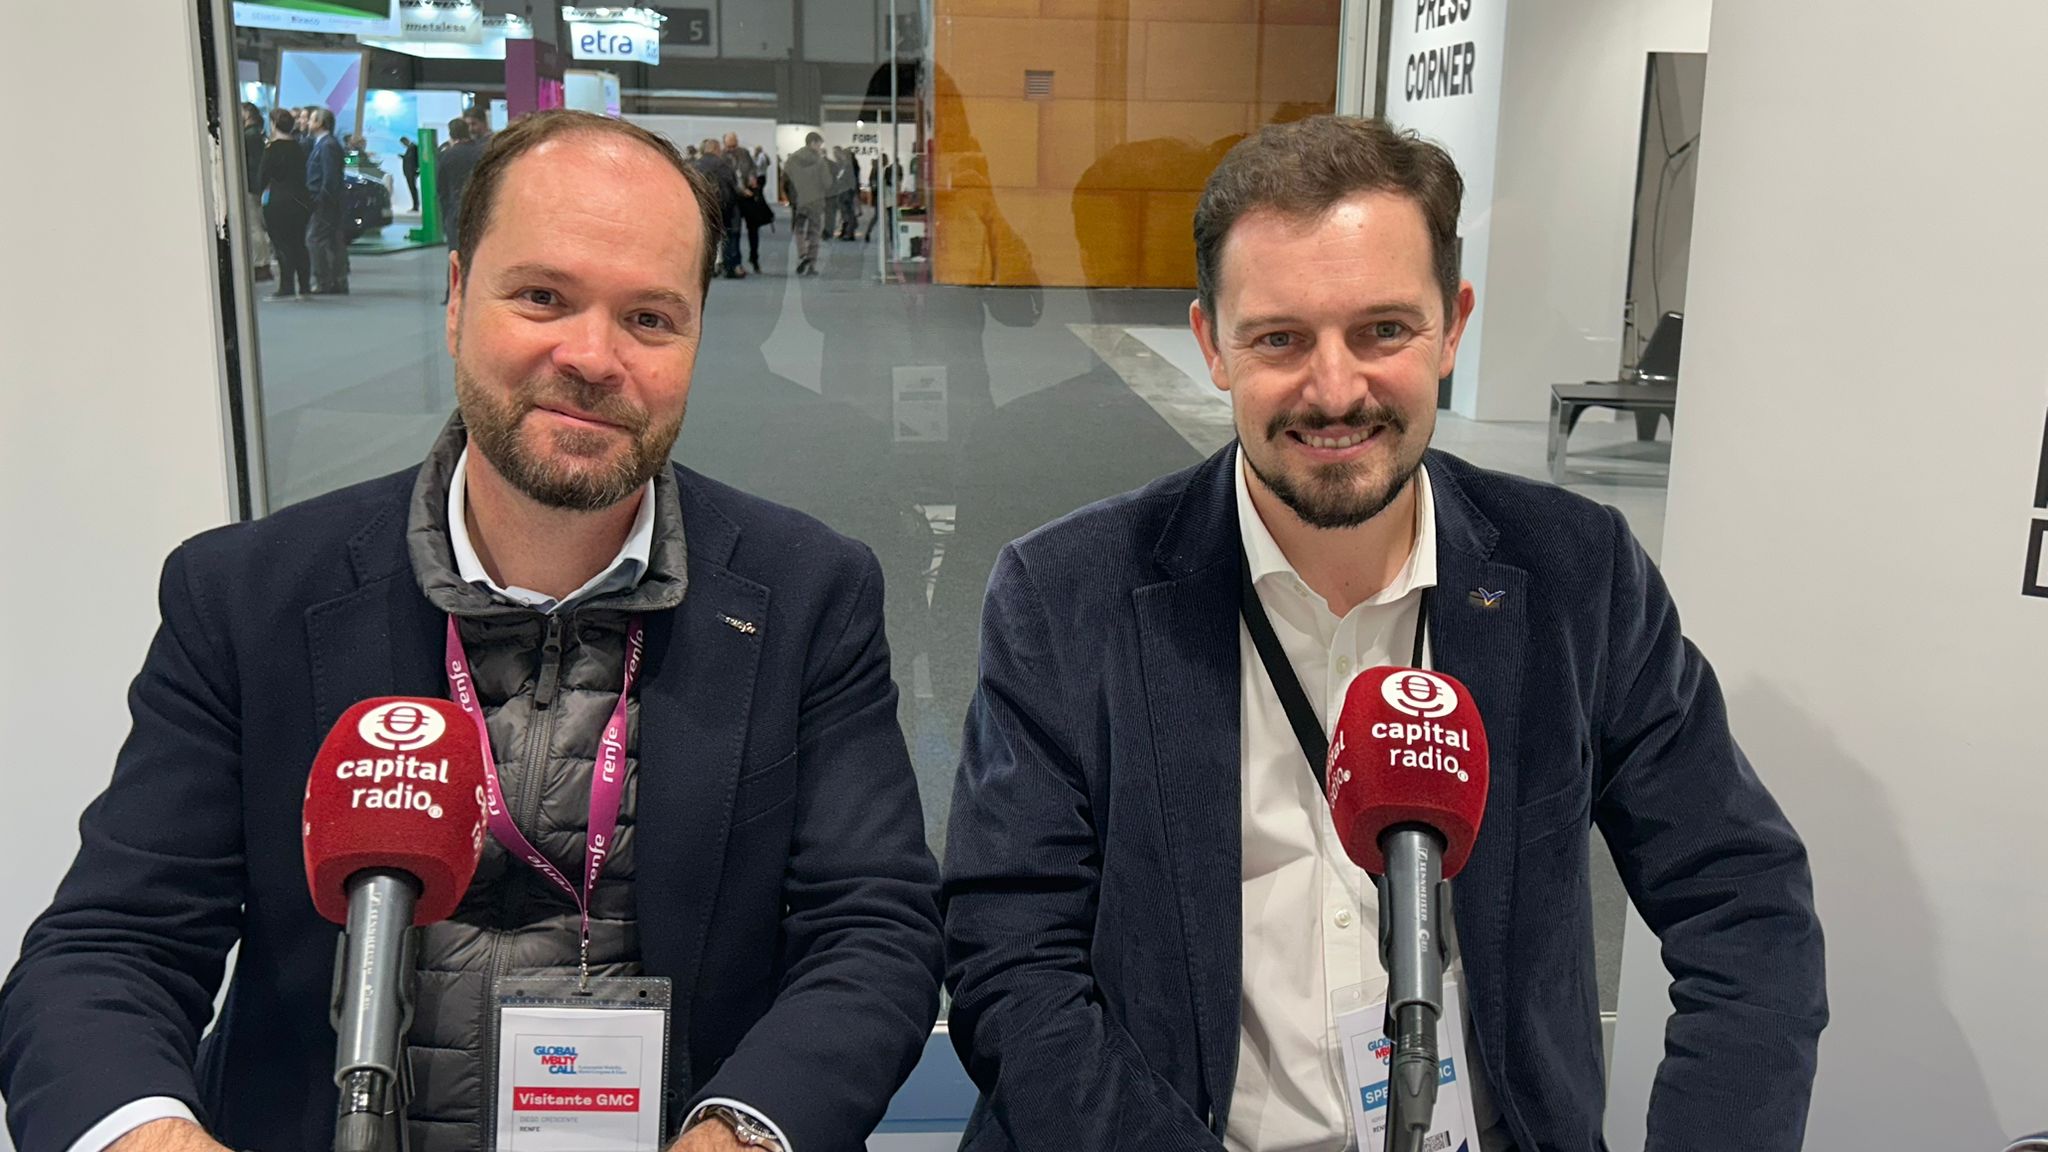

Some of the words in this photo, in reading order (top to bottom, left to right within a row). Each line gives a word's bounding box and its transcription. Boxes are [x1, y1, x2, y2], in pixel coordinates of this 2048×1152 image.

[1415, 0, 1472, 34] PRESS
[580, 30, 633, 54] etra
[1405, 41, 1475, 102] CORNER
[627, 630, 644, 683] renfe
[450, 659, 474, 713] renfe
[1371, 721, 1471, 752] capital
[336, 754, 449, 784] capital
[602, 726, 623, 783] renfe
[1389, 745, 1460, 774] radio
[351, 782, 432, 811] radio
[527, 854, 572, 893] renfe
[588, 833, 605, 890] renfe
[533, 1045, 578, 1056] GLOBAL
[548, 1065, 577, 1075] CALL
[519, 1093, 592, 1106] Visitante
[596, 1094, 635, 1107] GMC
